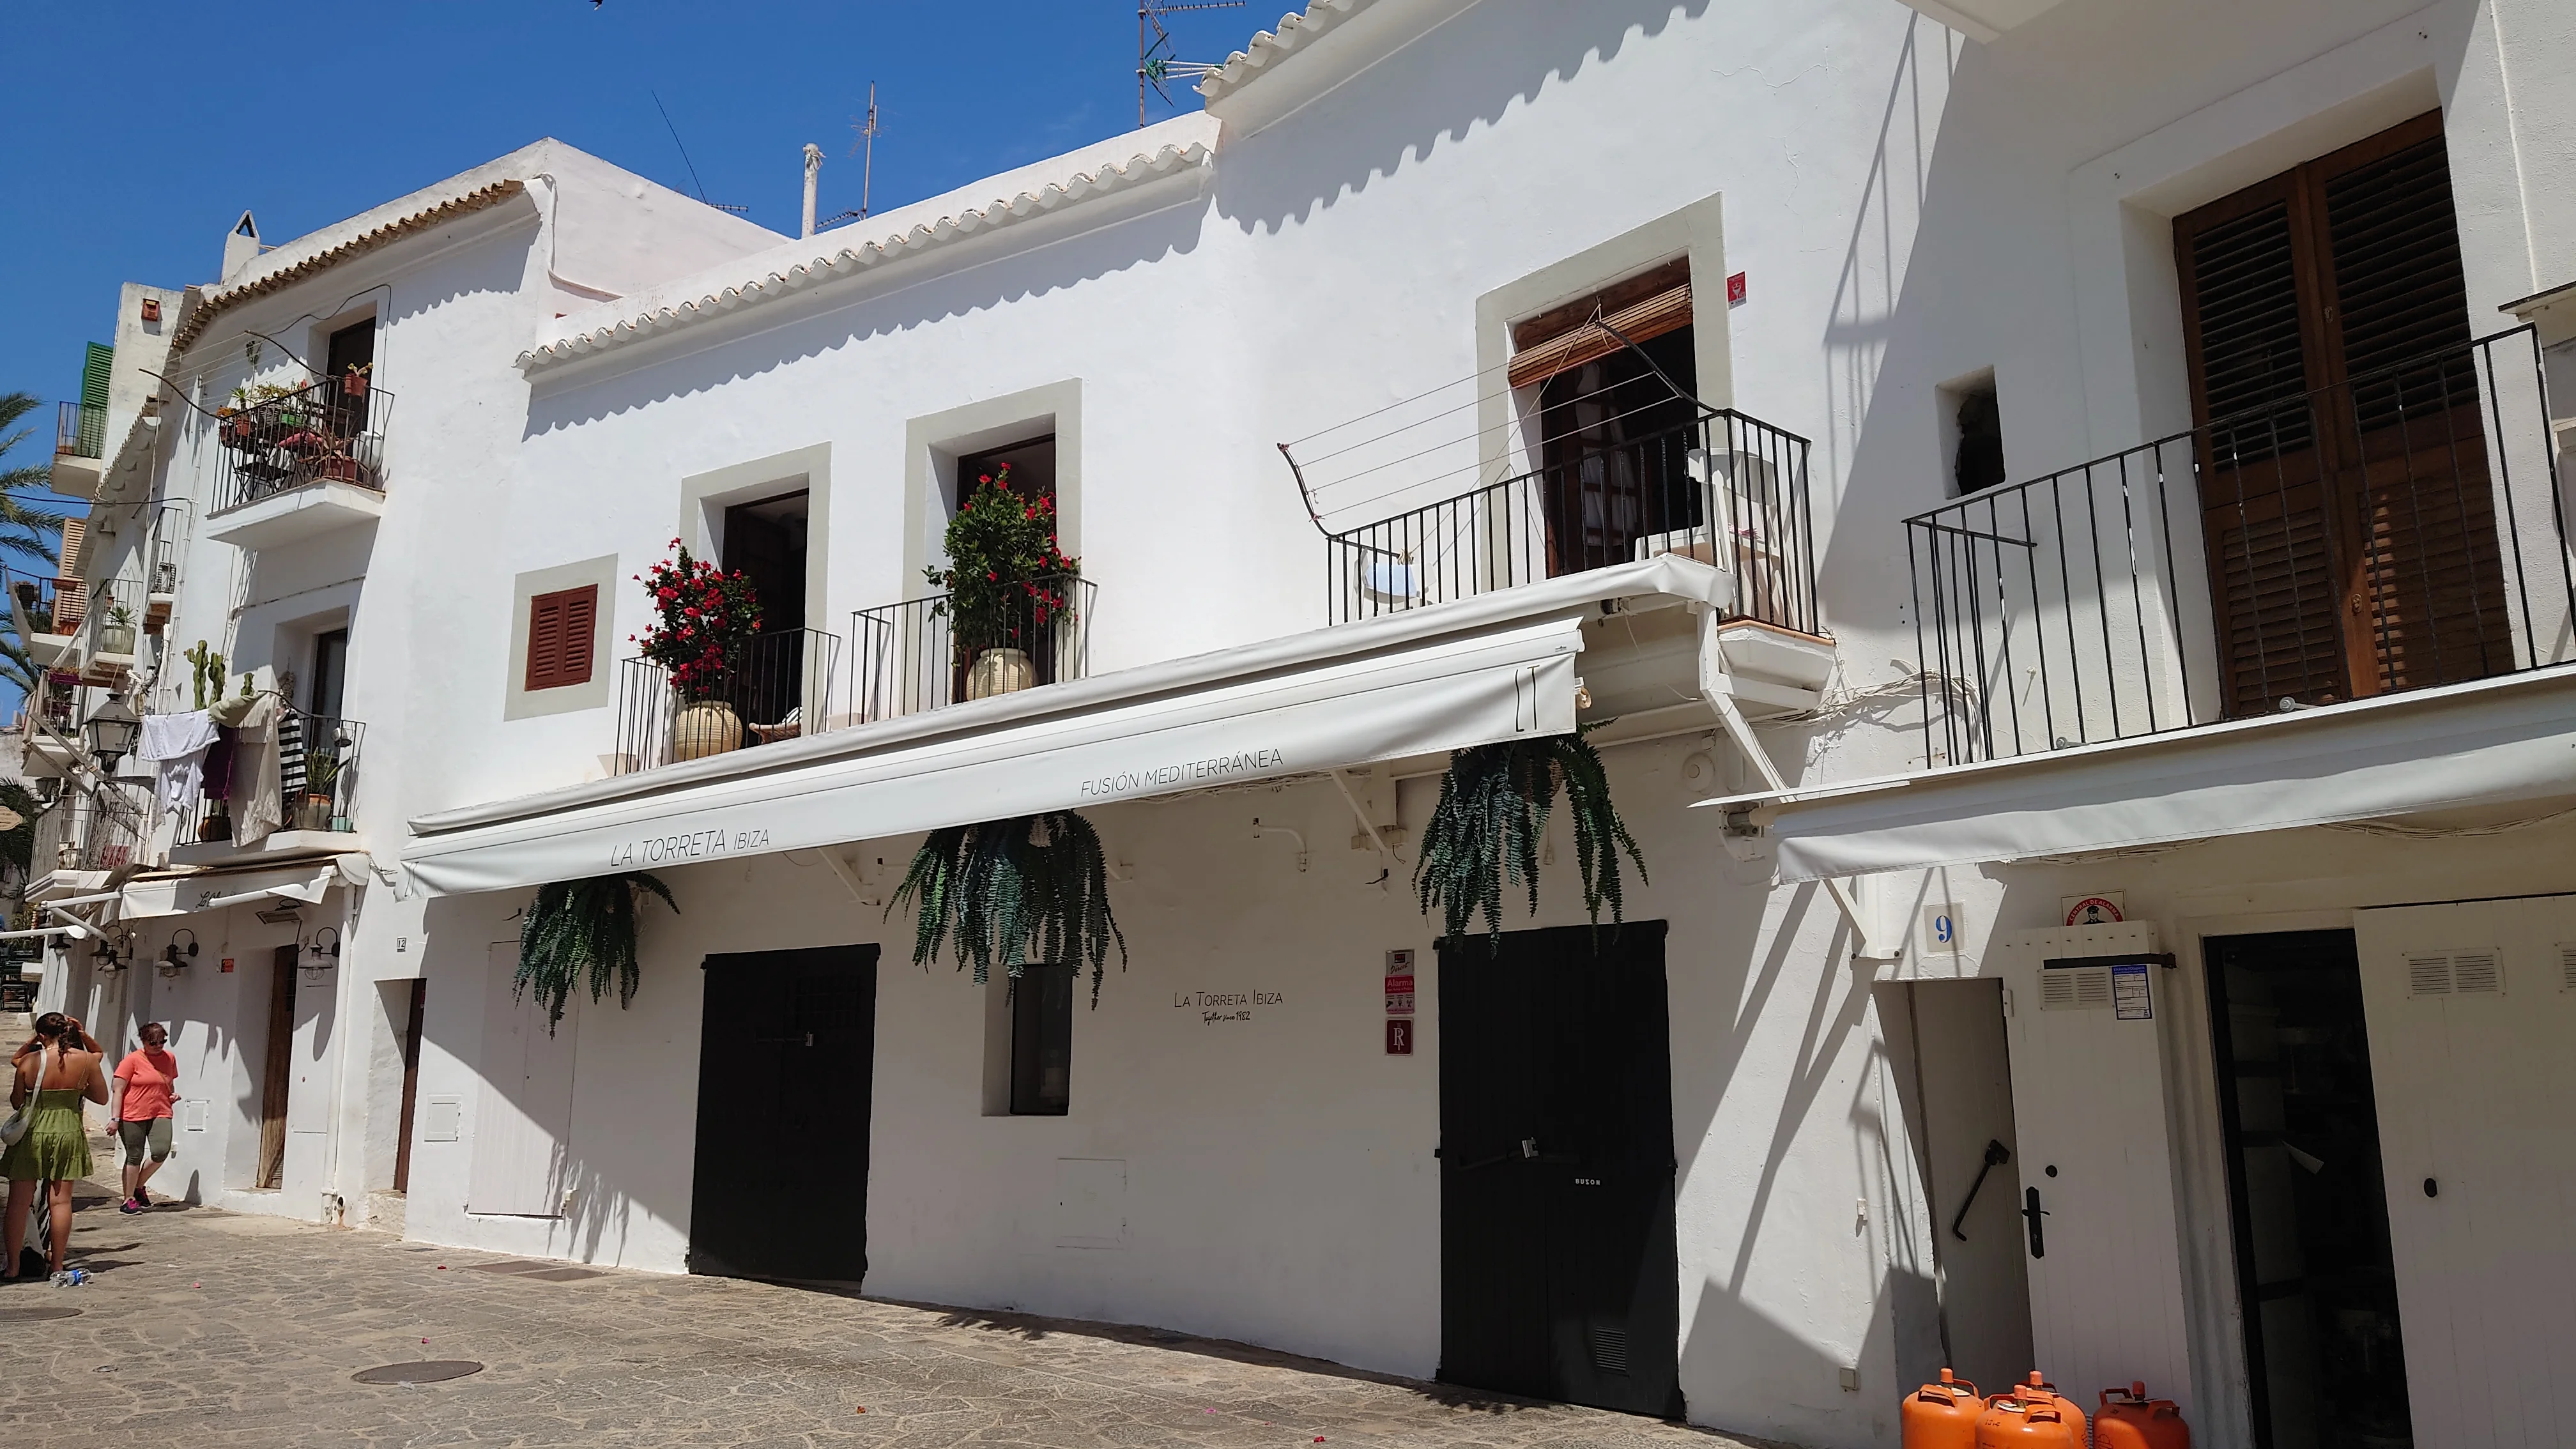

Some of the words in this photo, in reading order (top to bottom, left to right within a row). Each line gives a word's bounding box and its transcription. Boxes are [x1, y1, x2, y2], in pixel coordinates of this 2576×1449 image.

[1081, 771, 1140, 797] FUSIÓN
[1144, 748, 1284, 786] MEDITERRÁNEA
[611, 843, 632, 866] LA
[642, 829, 726, 862] TORRETA
[733, 829, 769, 850] IBIZA
[2069, 901, 2089, 921] CENTRAL
[2099, 900, 2119, 917] ALARMA
[1935, 915, 1952, 943] 9
[398, 939, 405, 948] 12
[1387, 978, 1413, 987] Alarma
[1174, 992, 1191, 1008] LA
[1196, 991, 1248, 1007] TORRETA
[1253, 989, 1284, 1005] IBIZA
[1202, 1011, 1222, 1026] Together
[1223, 1014, 1236, 1022] since
[1236, 1011, 1250, 1022] 1982
